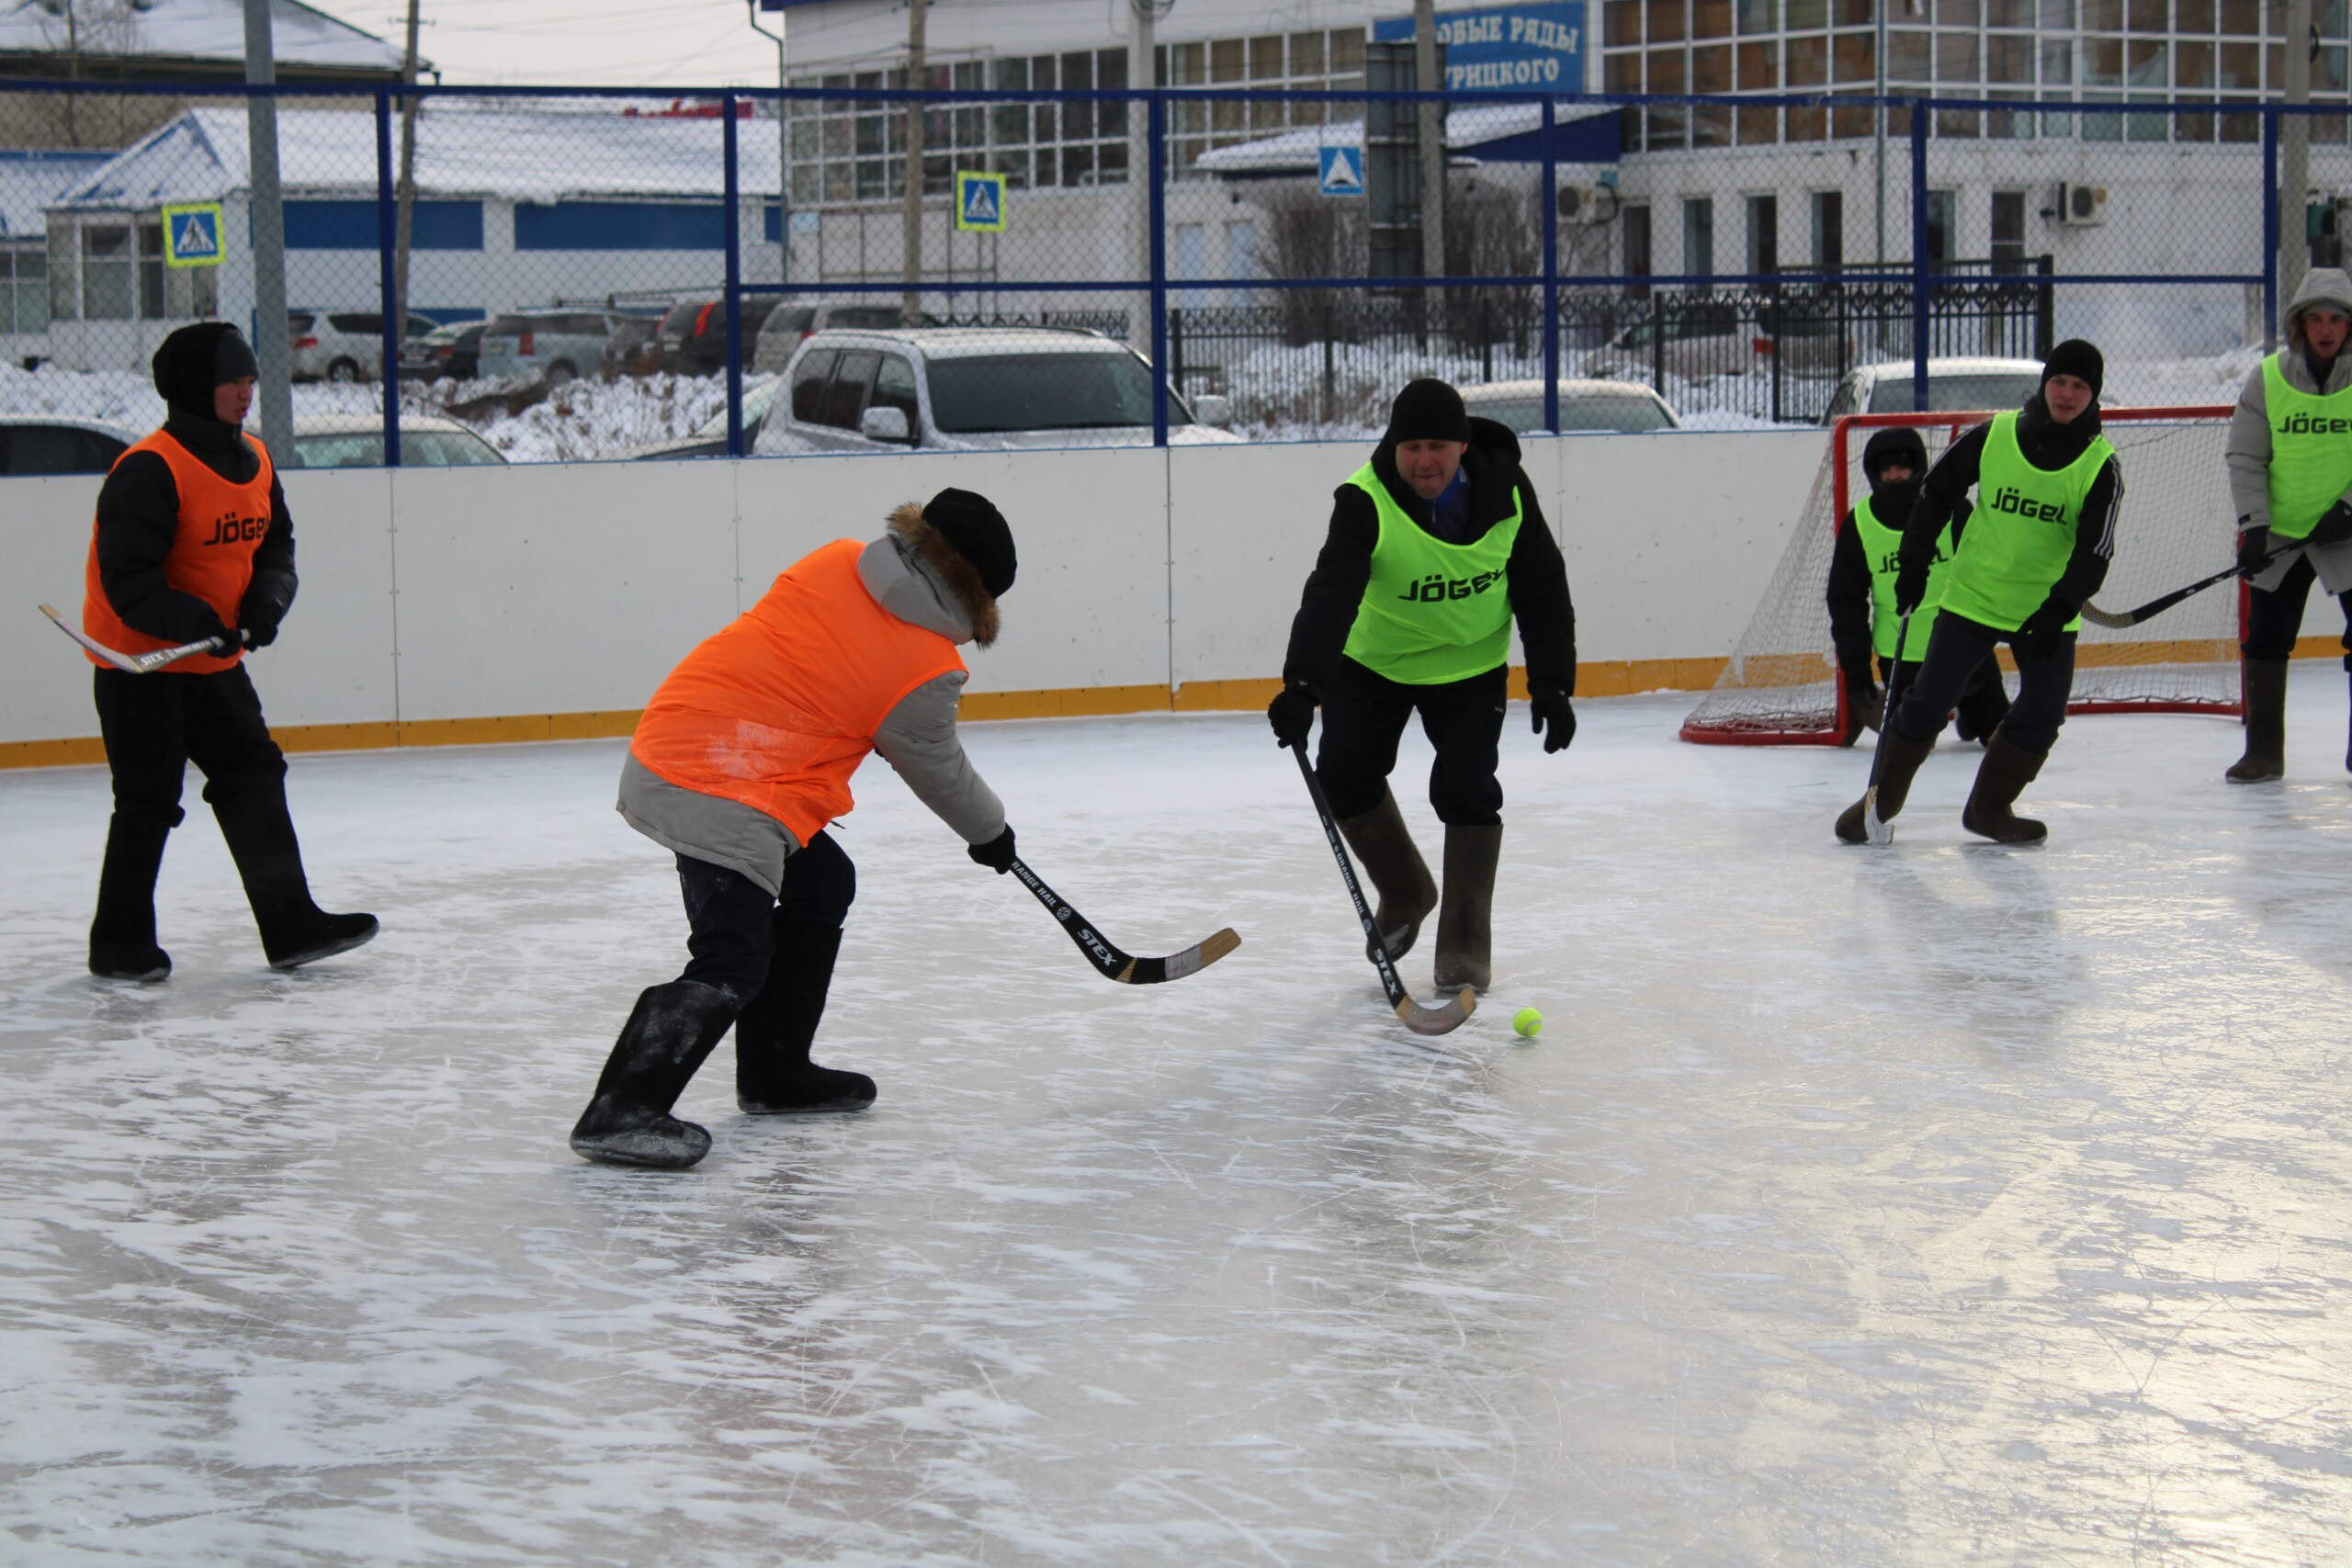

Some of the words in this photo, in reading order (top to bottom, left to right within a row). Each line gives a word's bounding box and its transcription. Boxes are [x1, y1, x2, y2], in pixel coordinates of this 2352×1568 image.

[1510, 16, 1579, 54] РЯДЫ
[1037, 886, 1057, 908] HAIL
[1077, 928, 1118, 967] STEX
